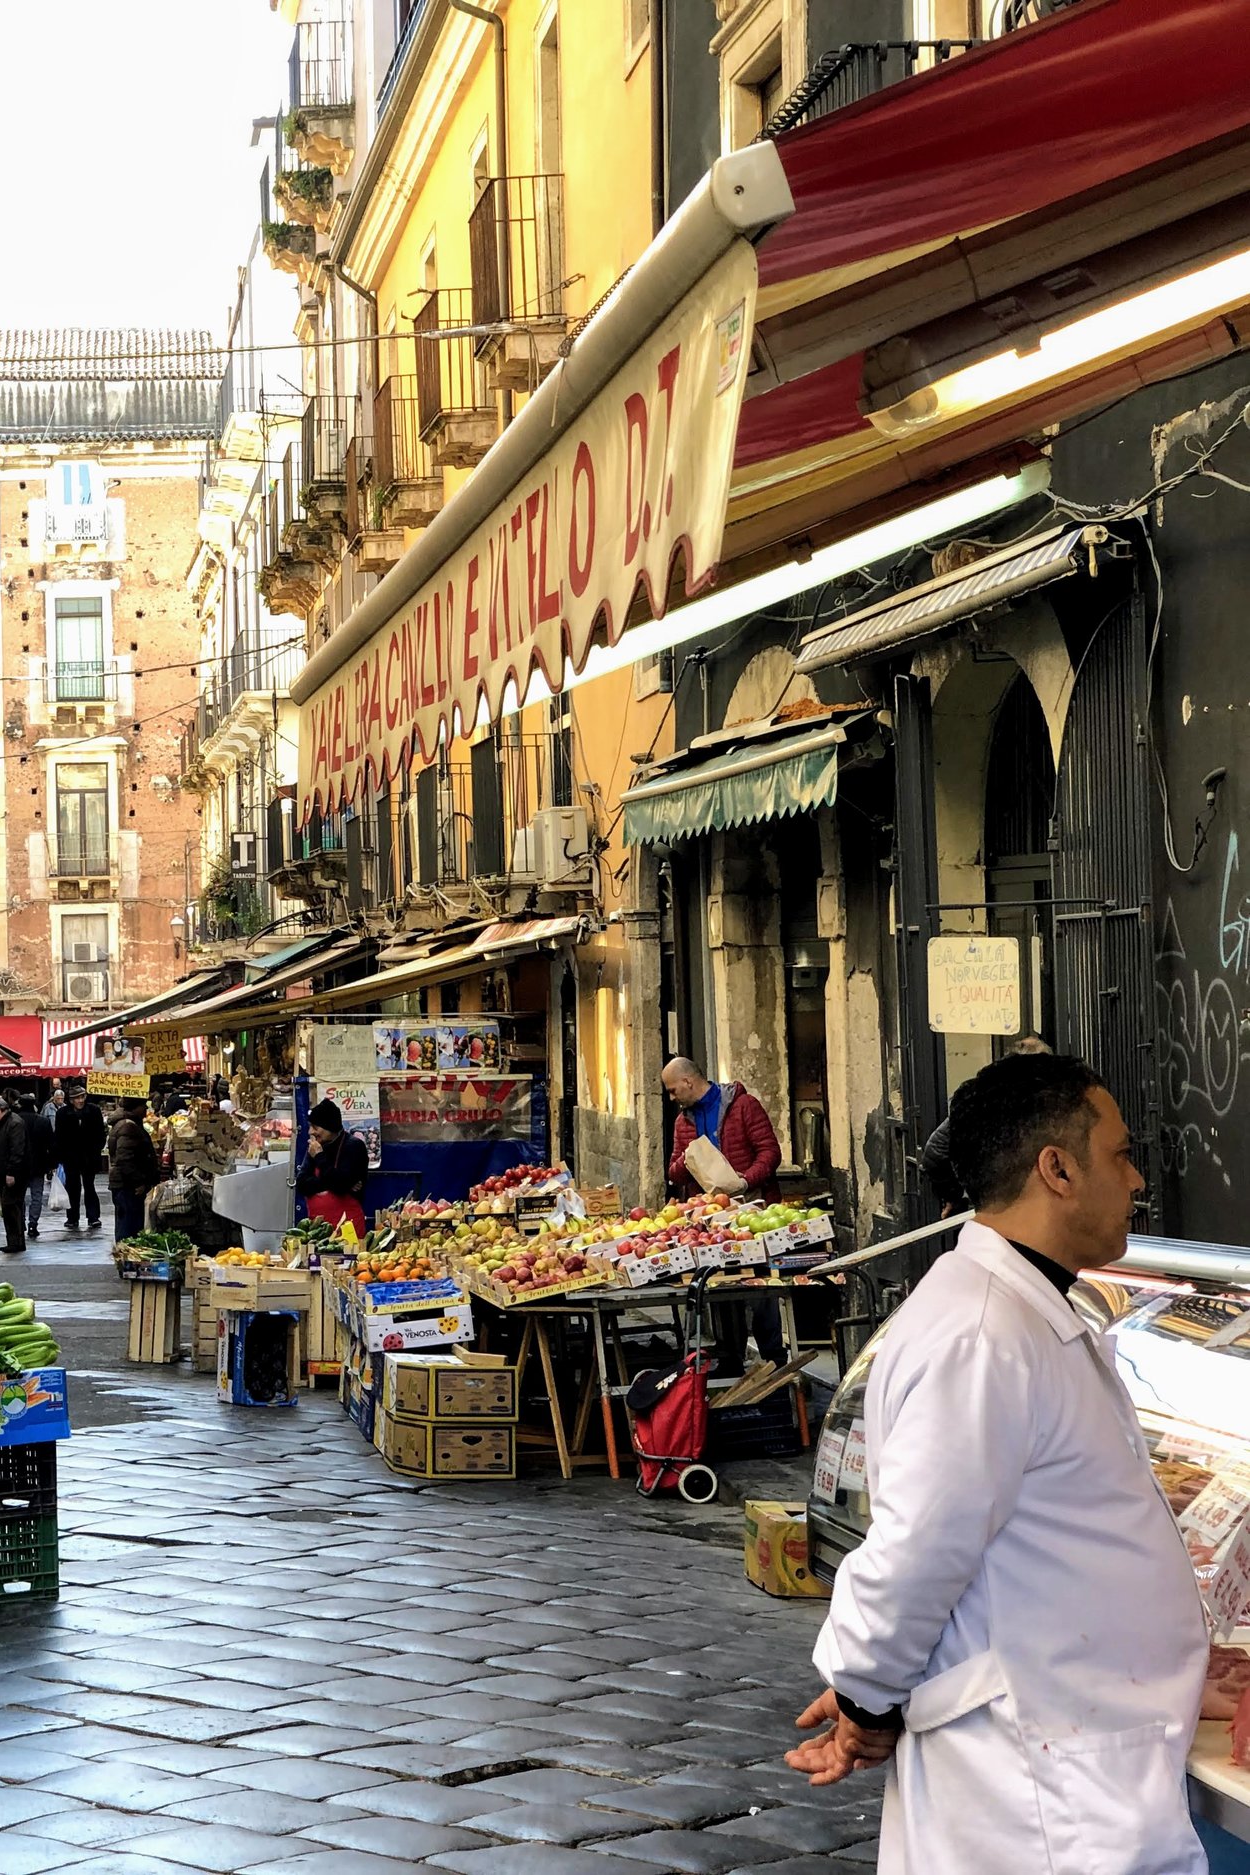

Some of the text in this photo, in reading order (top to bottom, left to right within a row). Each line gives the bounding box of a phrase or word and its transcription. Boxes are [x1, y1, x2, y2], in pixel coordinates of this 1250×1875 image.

[463, 554, 479, 682] E
[233, 834, 254, 867] T
[87, 1071, 131, 1080] STUFFED
[88, 1078, 143, 1088] SANDWICHES
[326, 1087, 366, 1100] SICILIA
[342, 1098, 373, 1111] VERA
[445, 1109, 503, 1122] GRILLO
[405, 1330, 437, 1340] VENOSTA
